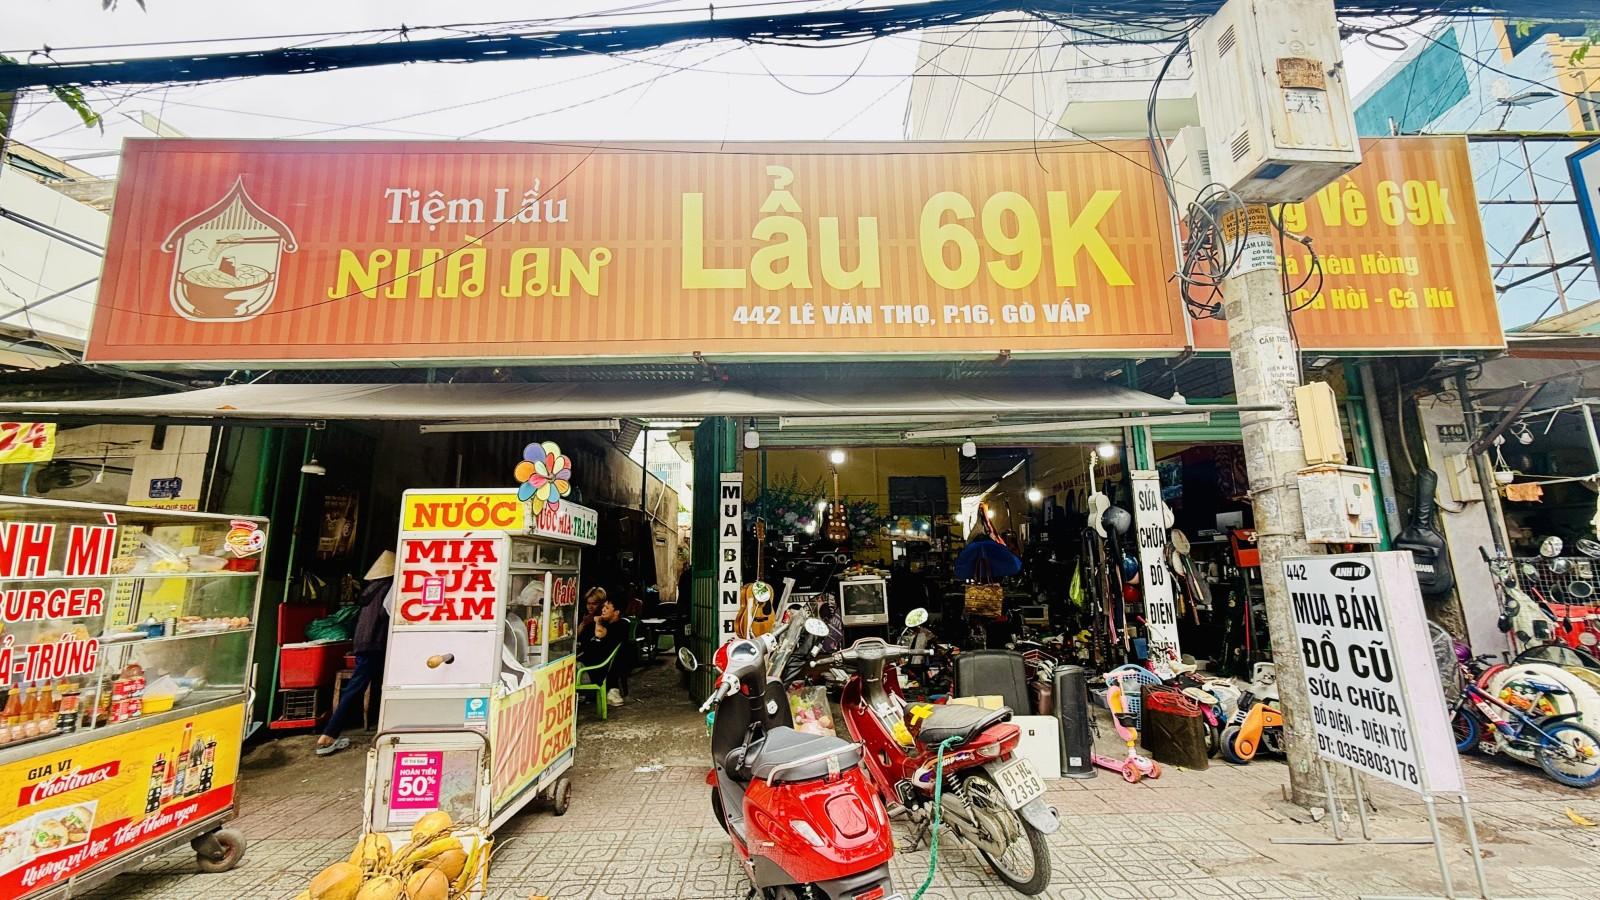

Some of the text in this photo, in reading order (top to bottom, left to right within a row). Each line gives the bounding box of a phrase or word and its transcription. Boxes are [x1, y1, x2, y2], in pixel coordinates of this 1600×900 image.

[384, 177, 568, 231] Tiệm Lẩu
[1316, 175, 1369, 227] Về
[1376, 179, 1456, 227] 69k
[681, 164, 1136, 290] Lẩu 69K
[327, 234, 612, 299] NHÀ AN
[1360, 250, 1419, 276] Hồng
[732, 296, 1091, 328] 442 LÊ VĂN THỌ, P.16, GÒ VẤP
[1330, 285, 1369, 310] Hồi
[1388, 287, 1418, 309] Cá
[1423, 286, 1456, 308] Hú
[412, 496, 516, 528] NƯỚC
[722, 485, 740, 537] MUA
[1138, 483, 1158, 512] SỬA
[64, 511, 117, 578] MÌ
[405, 532, 498, 563] MÍA
[1139, 523, 1165, 548] CHỮA
[723, 548, 738, 605] BÁN
[1286, 564, 1308, 581] 442
[1335, 565, 1366, 577] ANH VŨ
[0, 587, 105, 623] URGER
[400, 597, 496, 622] CAM
[1150, 597, 1174, 629] ĐIỆN
[1291, 586, 1384, 632] MUA BÁN
[1301, 629, 1394, 683] ĐỒ CŨ
[547, 660, 574, 697] MÍA
[1308, 673, 1402, 718] SỬA CHỮA
[541, 723, 573, 765] CAM
[1328, 708, 1354, 737] ĐIỆN
[1361, 717, 1390, 749] ĐIỆN
[1390, 722, 1408, 752] TỬ
[28, 767, 52, 780] GIA
[400, 767, 437, 776] HOÀN TIỀN
[1001, 762, 1032, 788] 81-H4
[1317, 733, 1418, 785] ĐT: 0355803178
[398, 776, 436, 797] 50%
[1011, 776, 1041, 804] 2359
